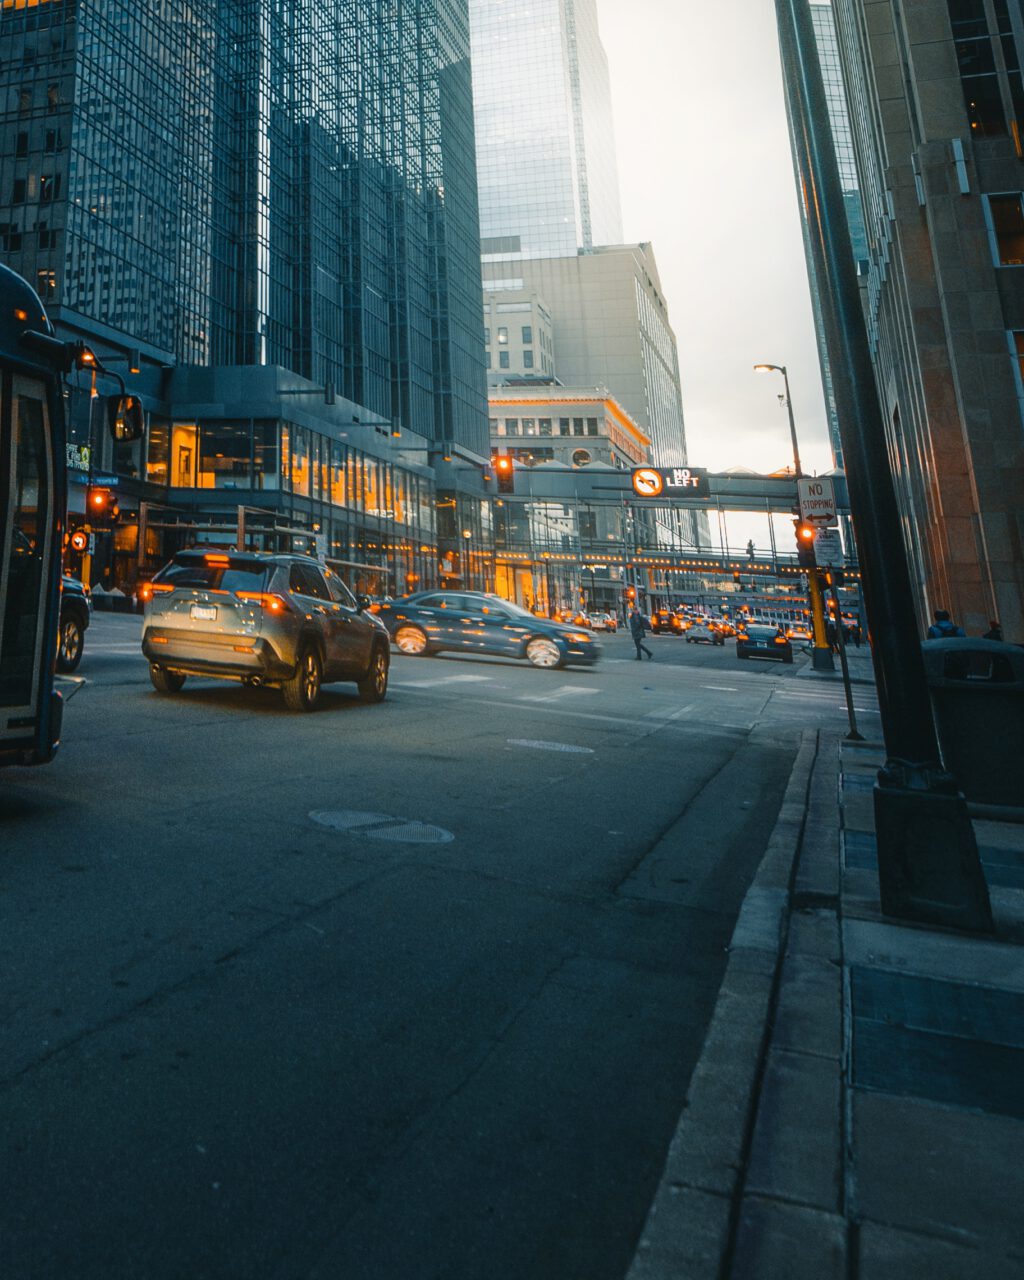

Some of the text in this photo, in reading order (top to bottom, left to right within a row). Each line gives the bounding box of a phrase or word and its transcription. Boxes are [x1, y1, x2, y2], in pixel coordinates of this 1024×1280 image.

[673, 468, 691, 479] NO
[666, 477, 698, 487] LEFT
[808, 483, 823, 496] NO
[802, 499, 833, 510] STOPPING
